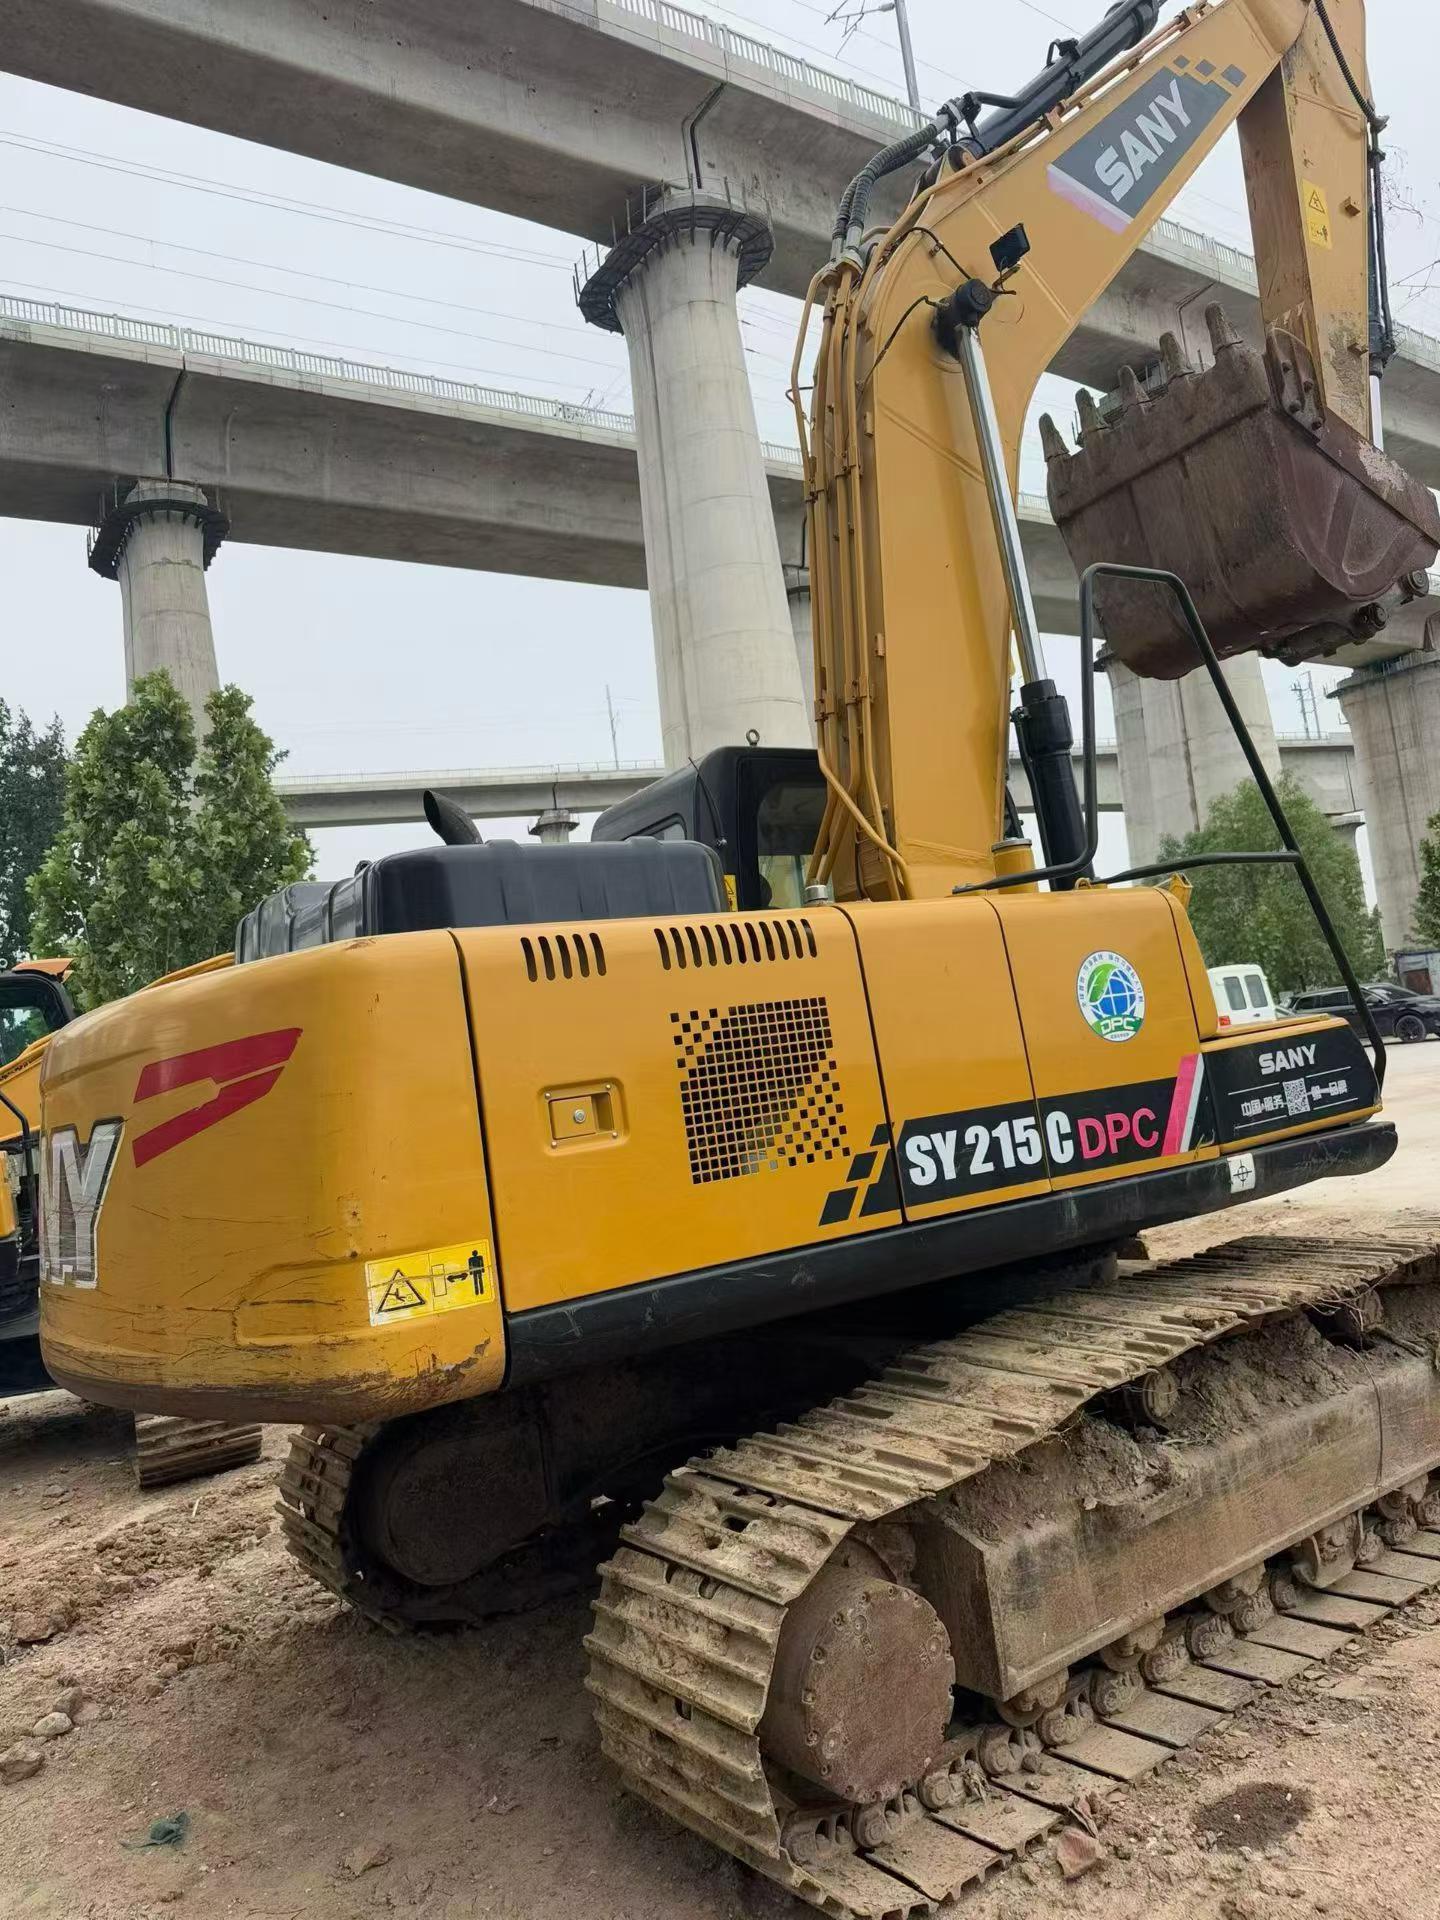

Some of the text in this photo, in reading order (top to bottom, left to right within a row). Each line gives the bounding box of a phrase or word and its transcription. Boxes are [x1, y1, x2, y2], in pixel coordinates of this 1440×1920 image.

[1094, 78, 1191, 203] SANY
[1100, 1016, 1135, 1035] DPC
[1258, 1043, 1317, 1075] SANY
[1078, 1107, 1159, 1160] DPC
